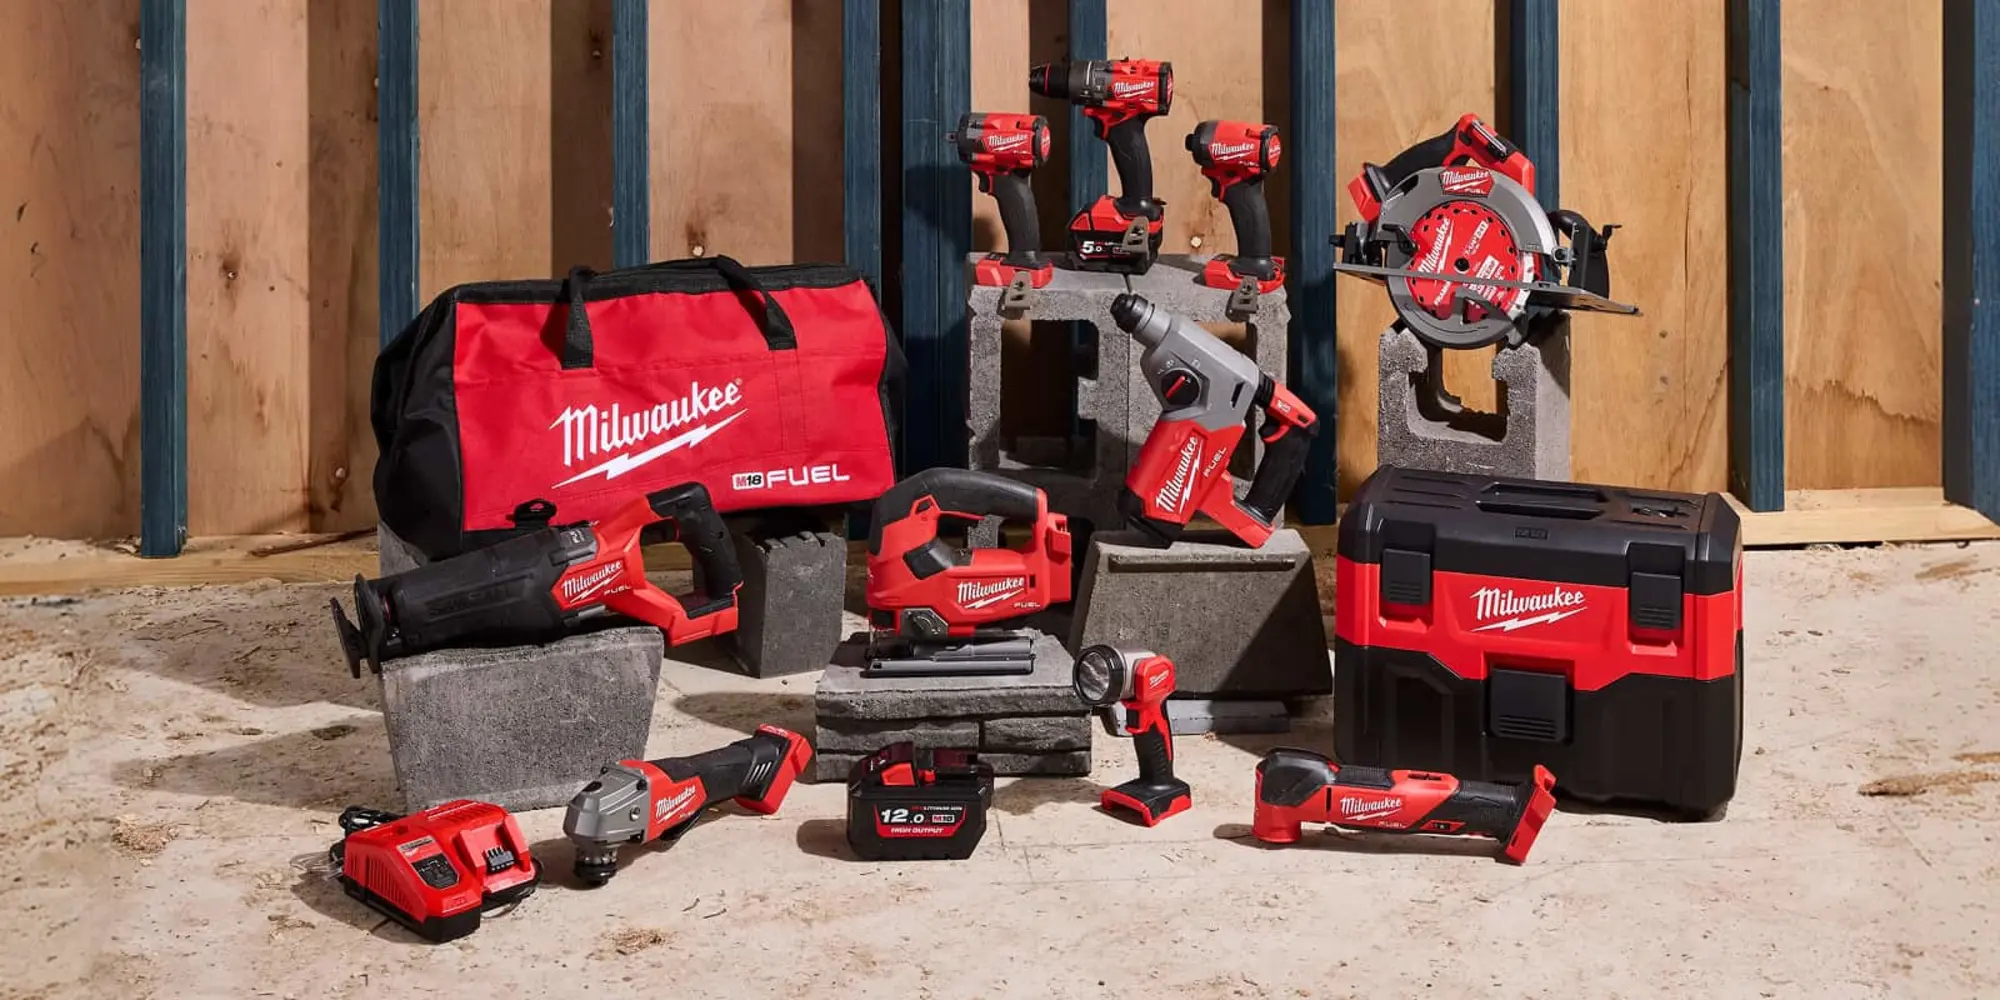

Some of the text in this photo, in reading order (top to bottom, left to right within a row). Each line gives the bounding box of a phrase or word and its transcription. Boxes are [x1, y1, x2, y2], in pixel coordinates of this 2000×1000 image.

[1082, 241, 1102, 253] 5.0
[549, 381, 742, 467] Milwaukee
[1156, 437, 1198, 511] Milwaukee
[1203, 447, 1227, 477] FUEL
[735, 464, 850, 489] M18 FUEL
[561, 561, 622, 598] Milwaukee
[957, 577, 1024, 603] Milwaukee
[1470, 586, 1585, 621] Milwaukee
[881, 808, 924, 824] 12.0
[1340, 797, 1401, 815] Milwaukee
